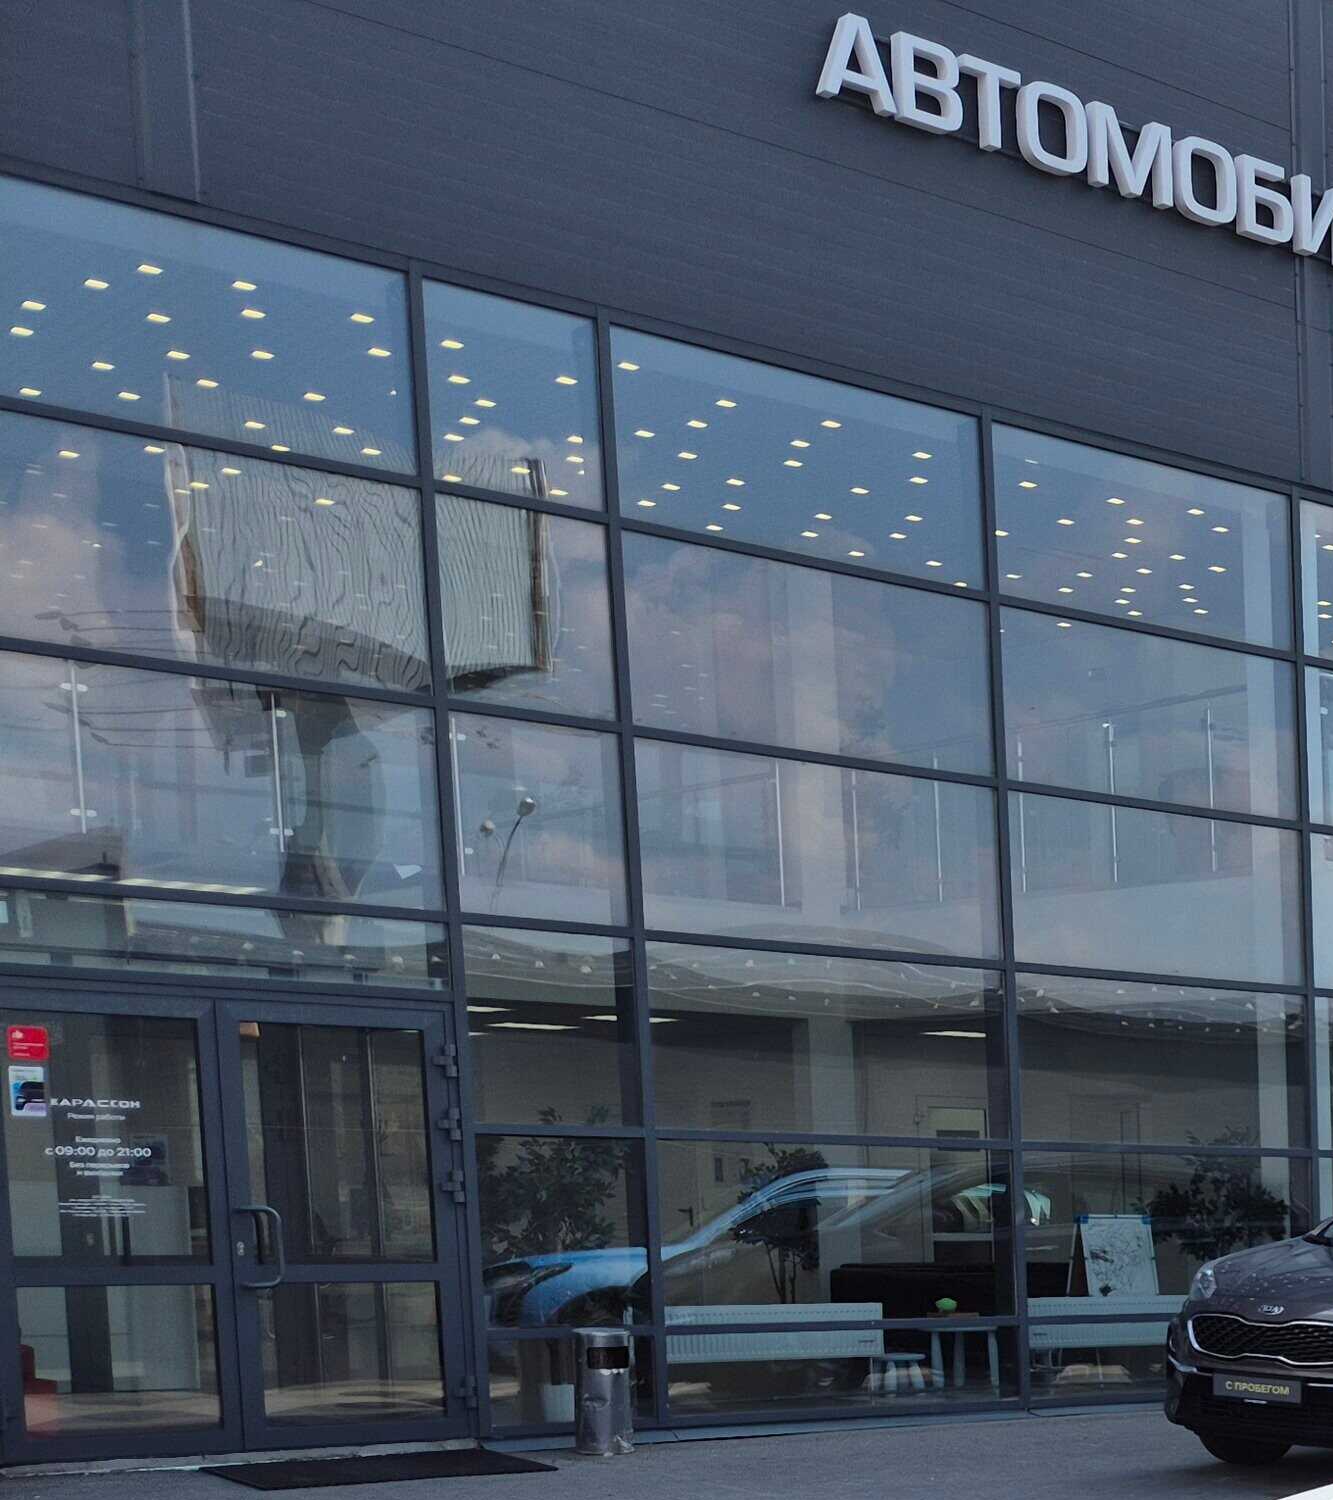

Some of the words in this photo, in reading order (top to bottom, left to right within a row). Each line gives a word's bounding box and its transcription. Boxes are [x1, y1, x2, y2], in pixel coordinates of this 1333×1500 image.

[55, 1146, 96, 1156] 09:00
[117, 1147, 151, 1157] 21:00
[1234, 1381, 1290, 1395] ПРОБЕГОМ
